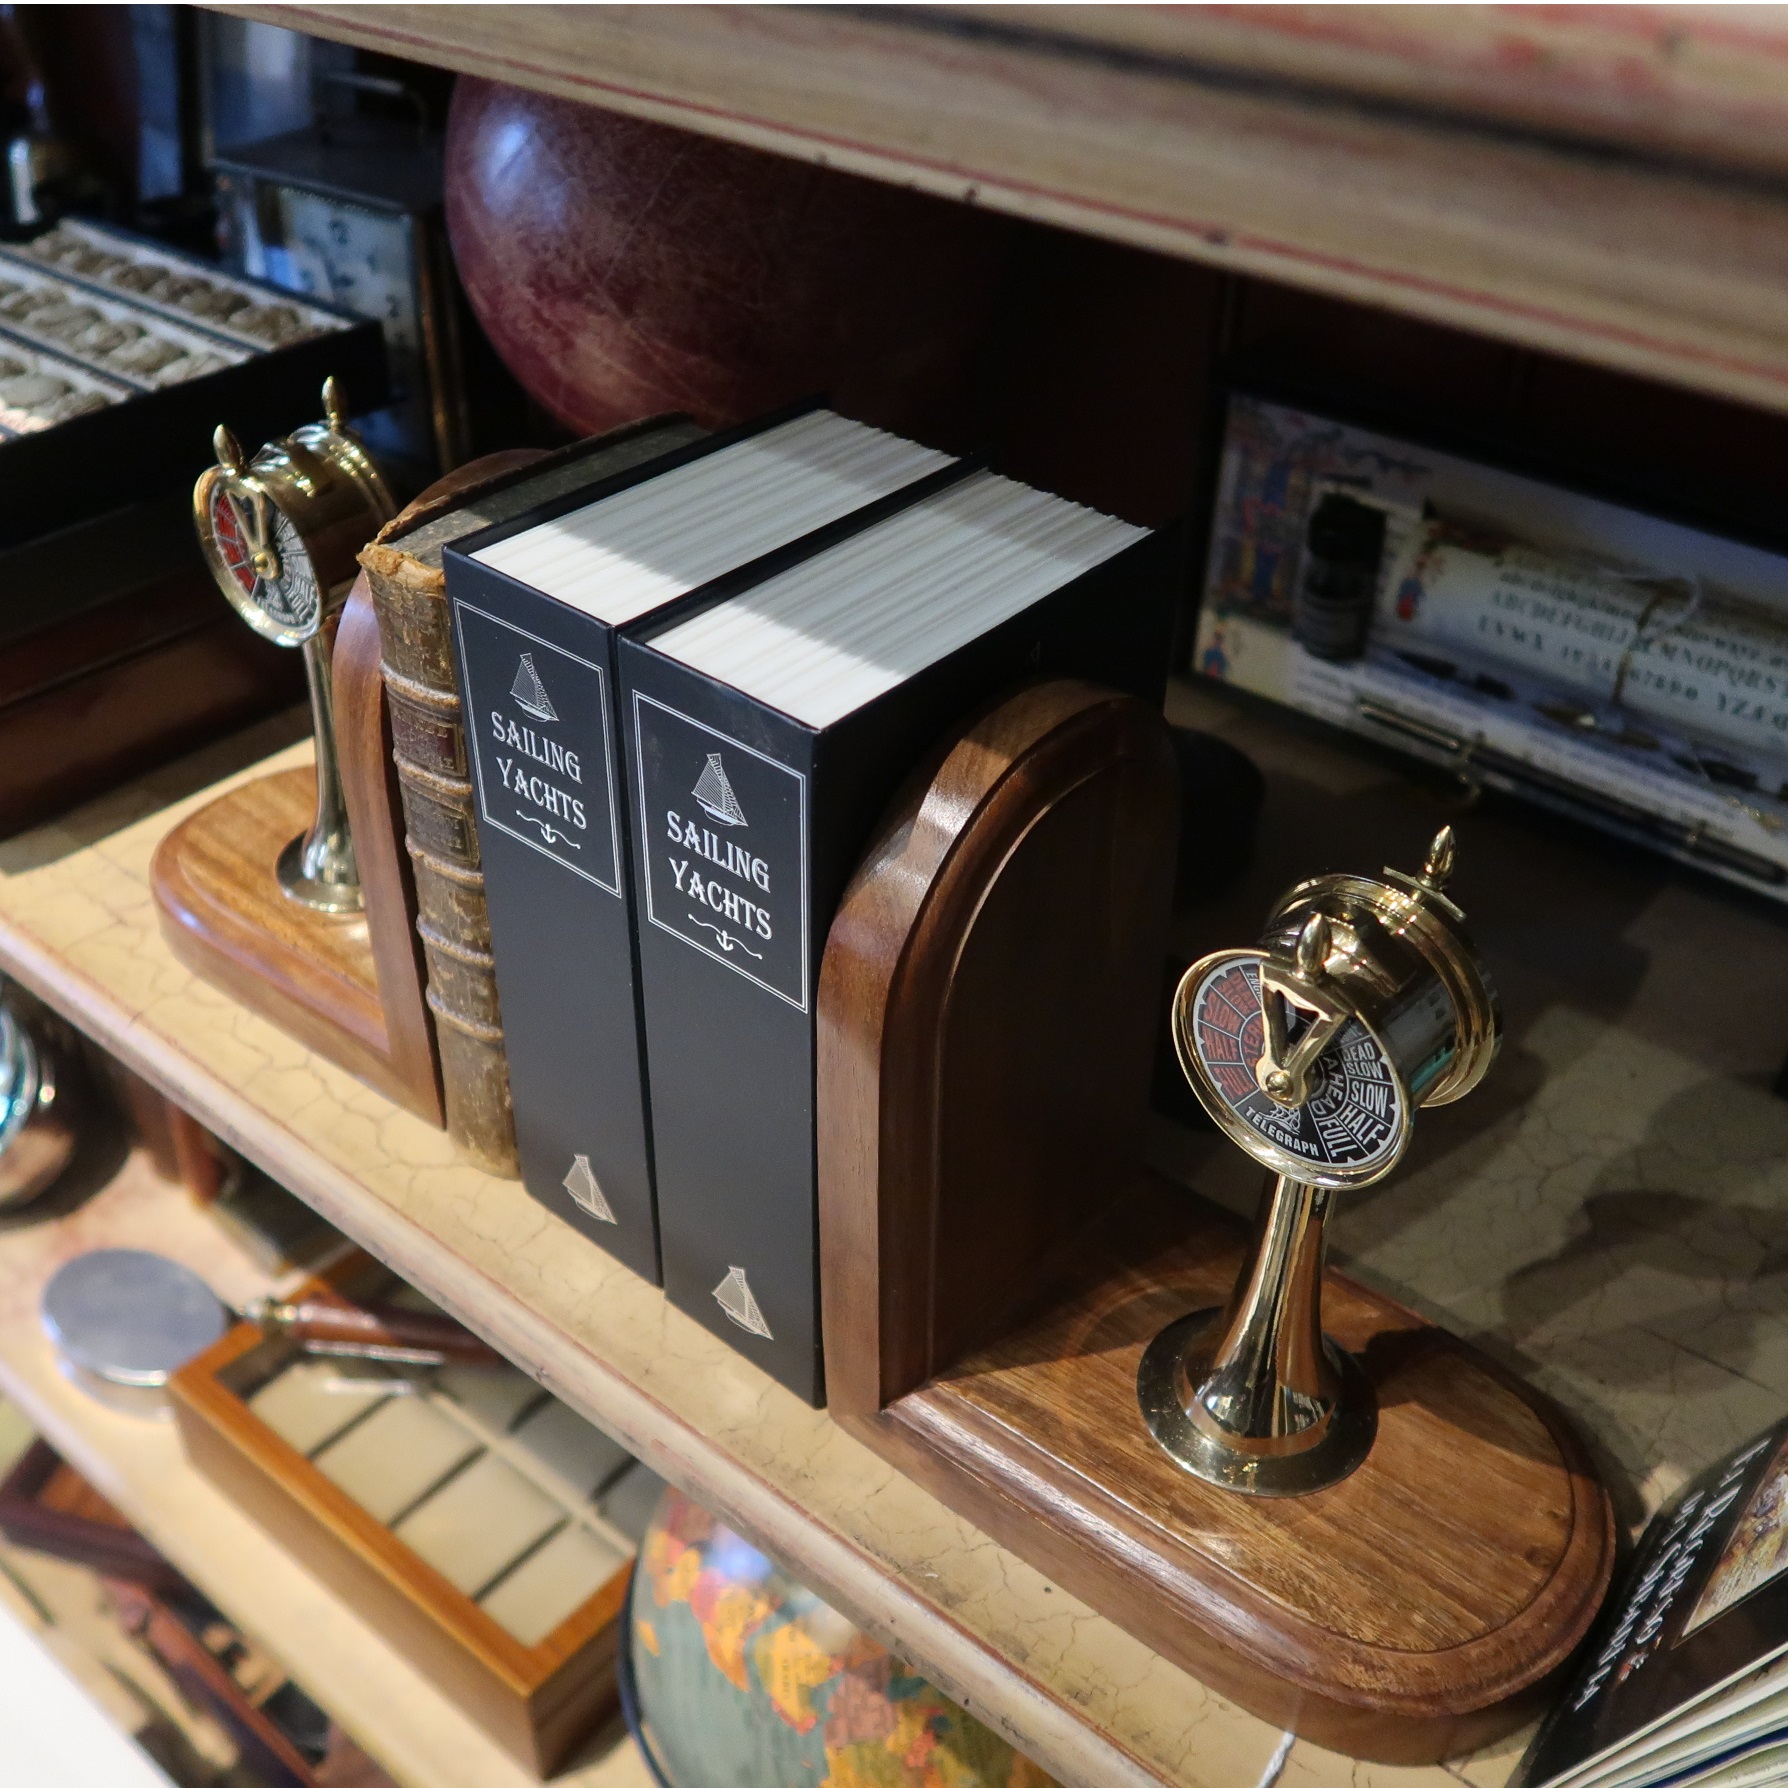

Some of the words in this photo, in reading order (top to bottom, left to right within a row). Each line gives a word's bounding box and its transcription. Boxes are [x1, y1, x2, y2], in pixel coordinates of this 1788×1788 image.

[491, 711, 583, 784] SAILING
[496, 757, 587, 830] YACHTS
[667, 811, 771, 893] SAILING
[669, 857, 772, 940] YACHTS
[1203, 1024, 1238, 1061] HALF
[1344, 1042, 1375, 1061] DEAD
[1312, 1056, 1344, 1116] AHEAD
[1347, 1062, 1384, 1080] SLOW
[1351, 1081, 1388, 1118] SLOW
[1244, 1106, 1320, 1157] TELEGRAPH
[1318, 1118, 1357, 1158] FULL
[1340, 1104, 1385, 1146] HALF
